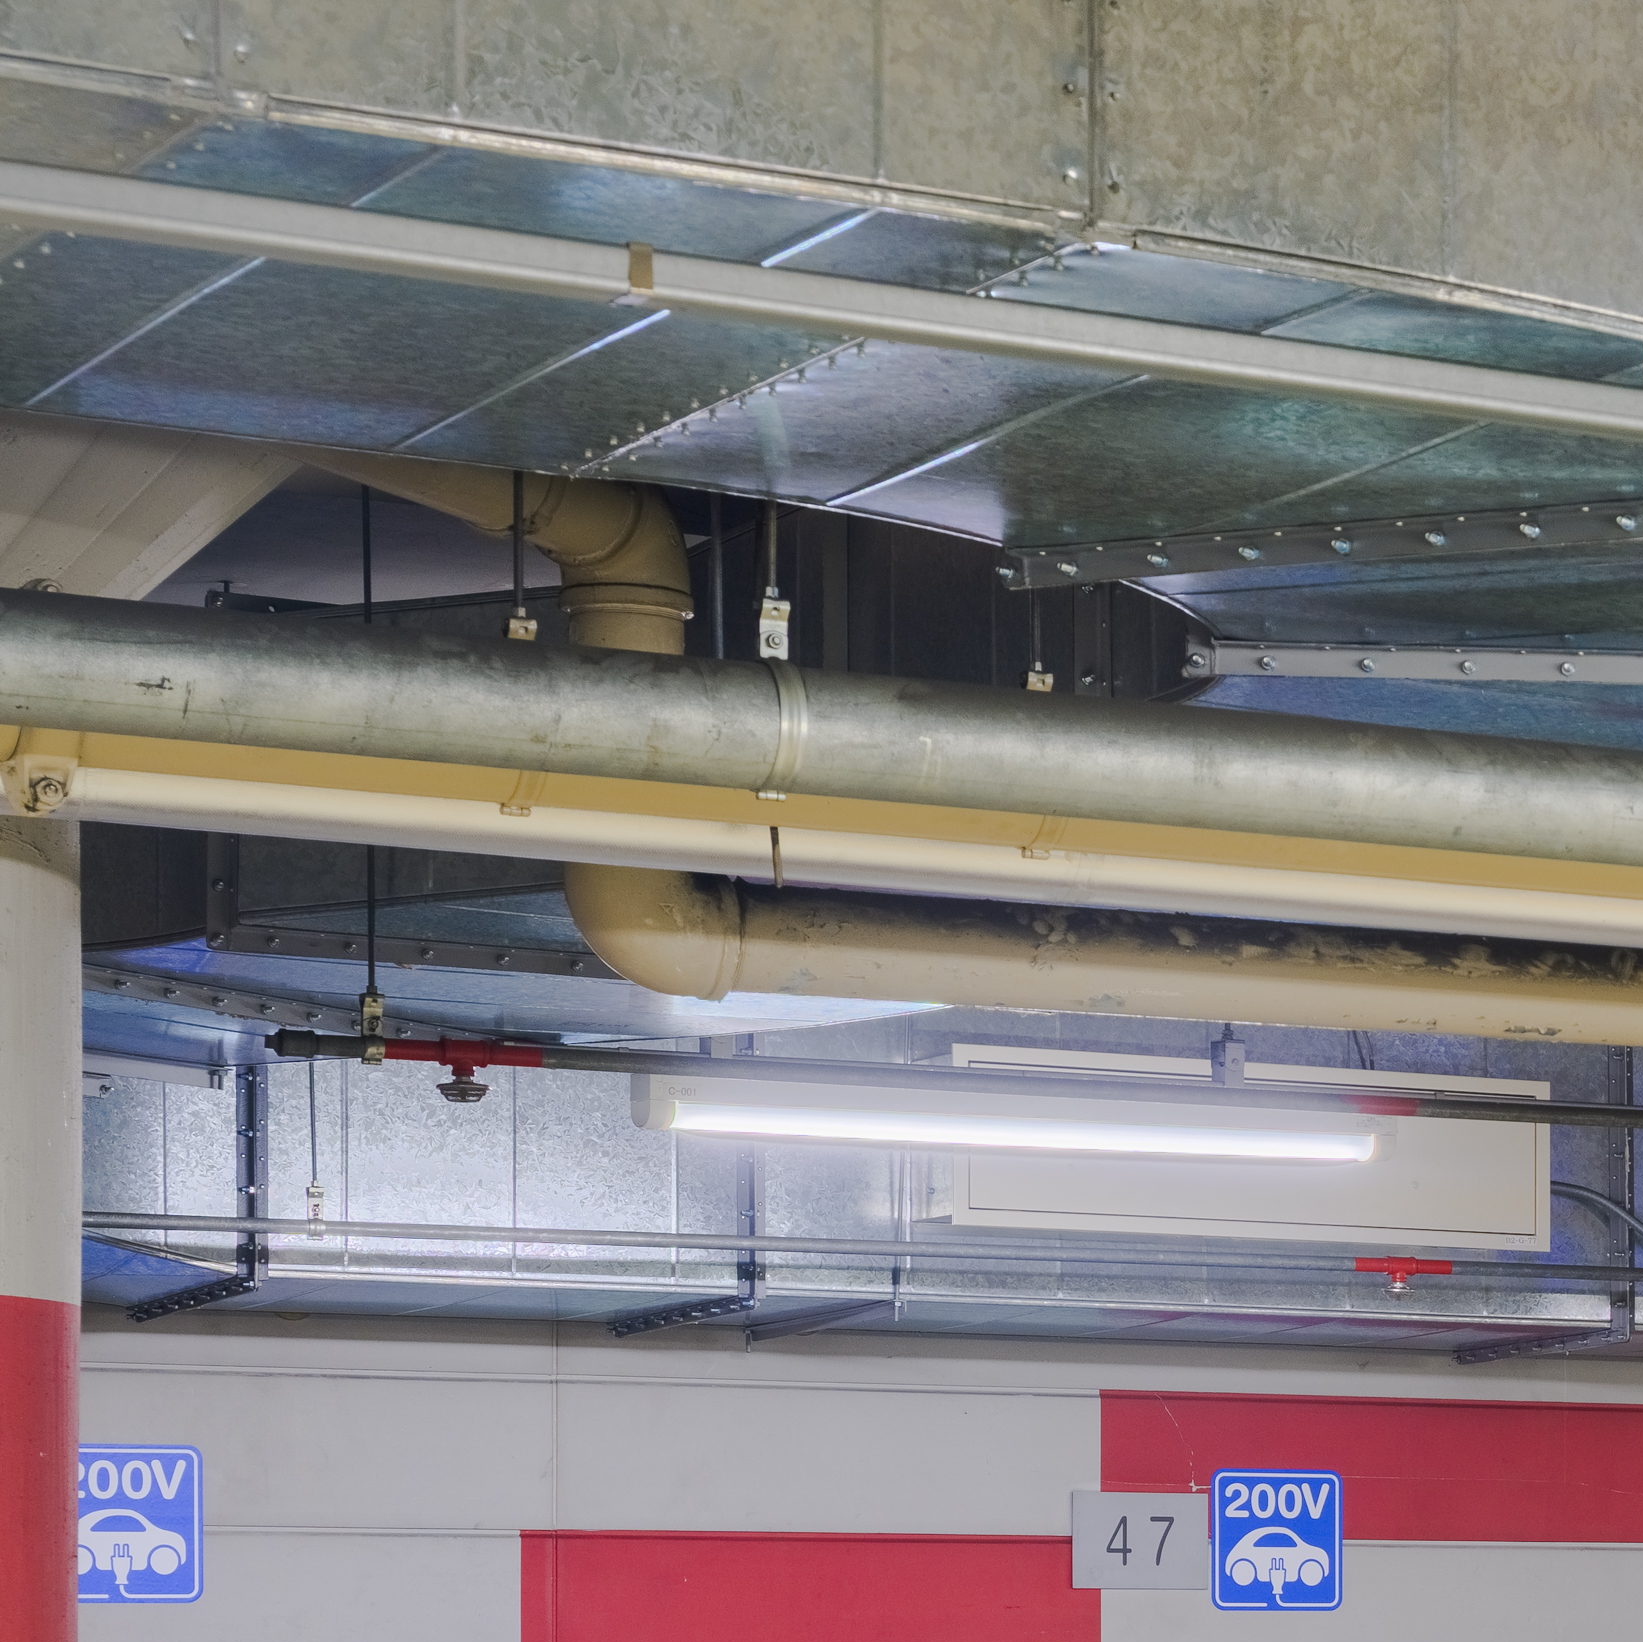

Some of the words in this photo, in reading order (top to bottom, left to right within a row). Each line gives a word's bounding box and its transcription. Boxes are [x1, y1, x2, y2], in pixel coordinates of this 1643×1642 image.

[668, 1086, 697, 1097] C-001
[1505, 1236, 1537, 1245] B2-G-77
[1224, 1482, 1331, 1520] 200V
[1105, 1515, 1176, 1568] 47
